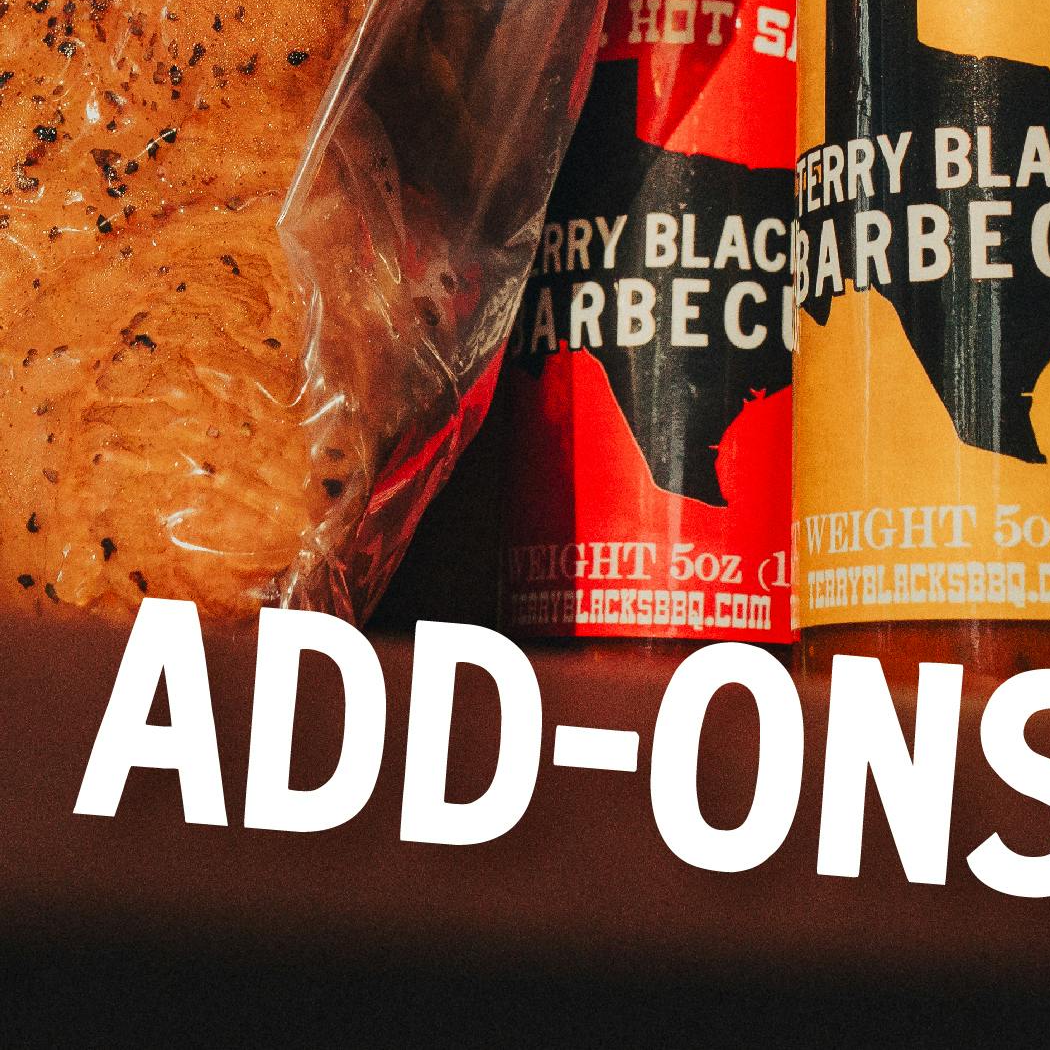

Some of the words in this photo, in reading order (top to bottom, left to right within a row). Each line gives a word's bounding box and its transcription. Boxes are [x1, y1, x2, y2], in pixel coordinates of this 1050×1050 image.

[797, 131, 912, 217] TERRY
[538, 214, 627, 273] RRY
[805, 505, 976, 556] WEIGHT
